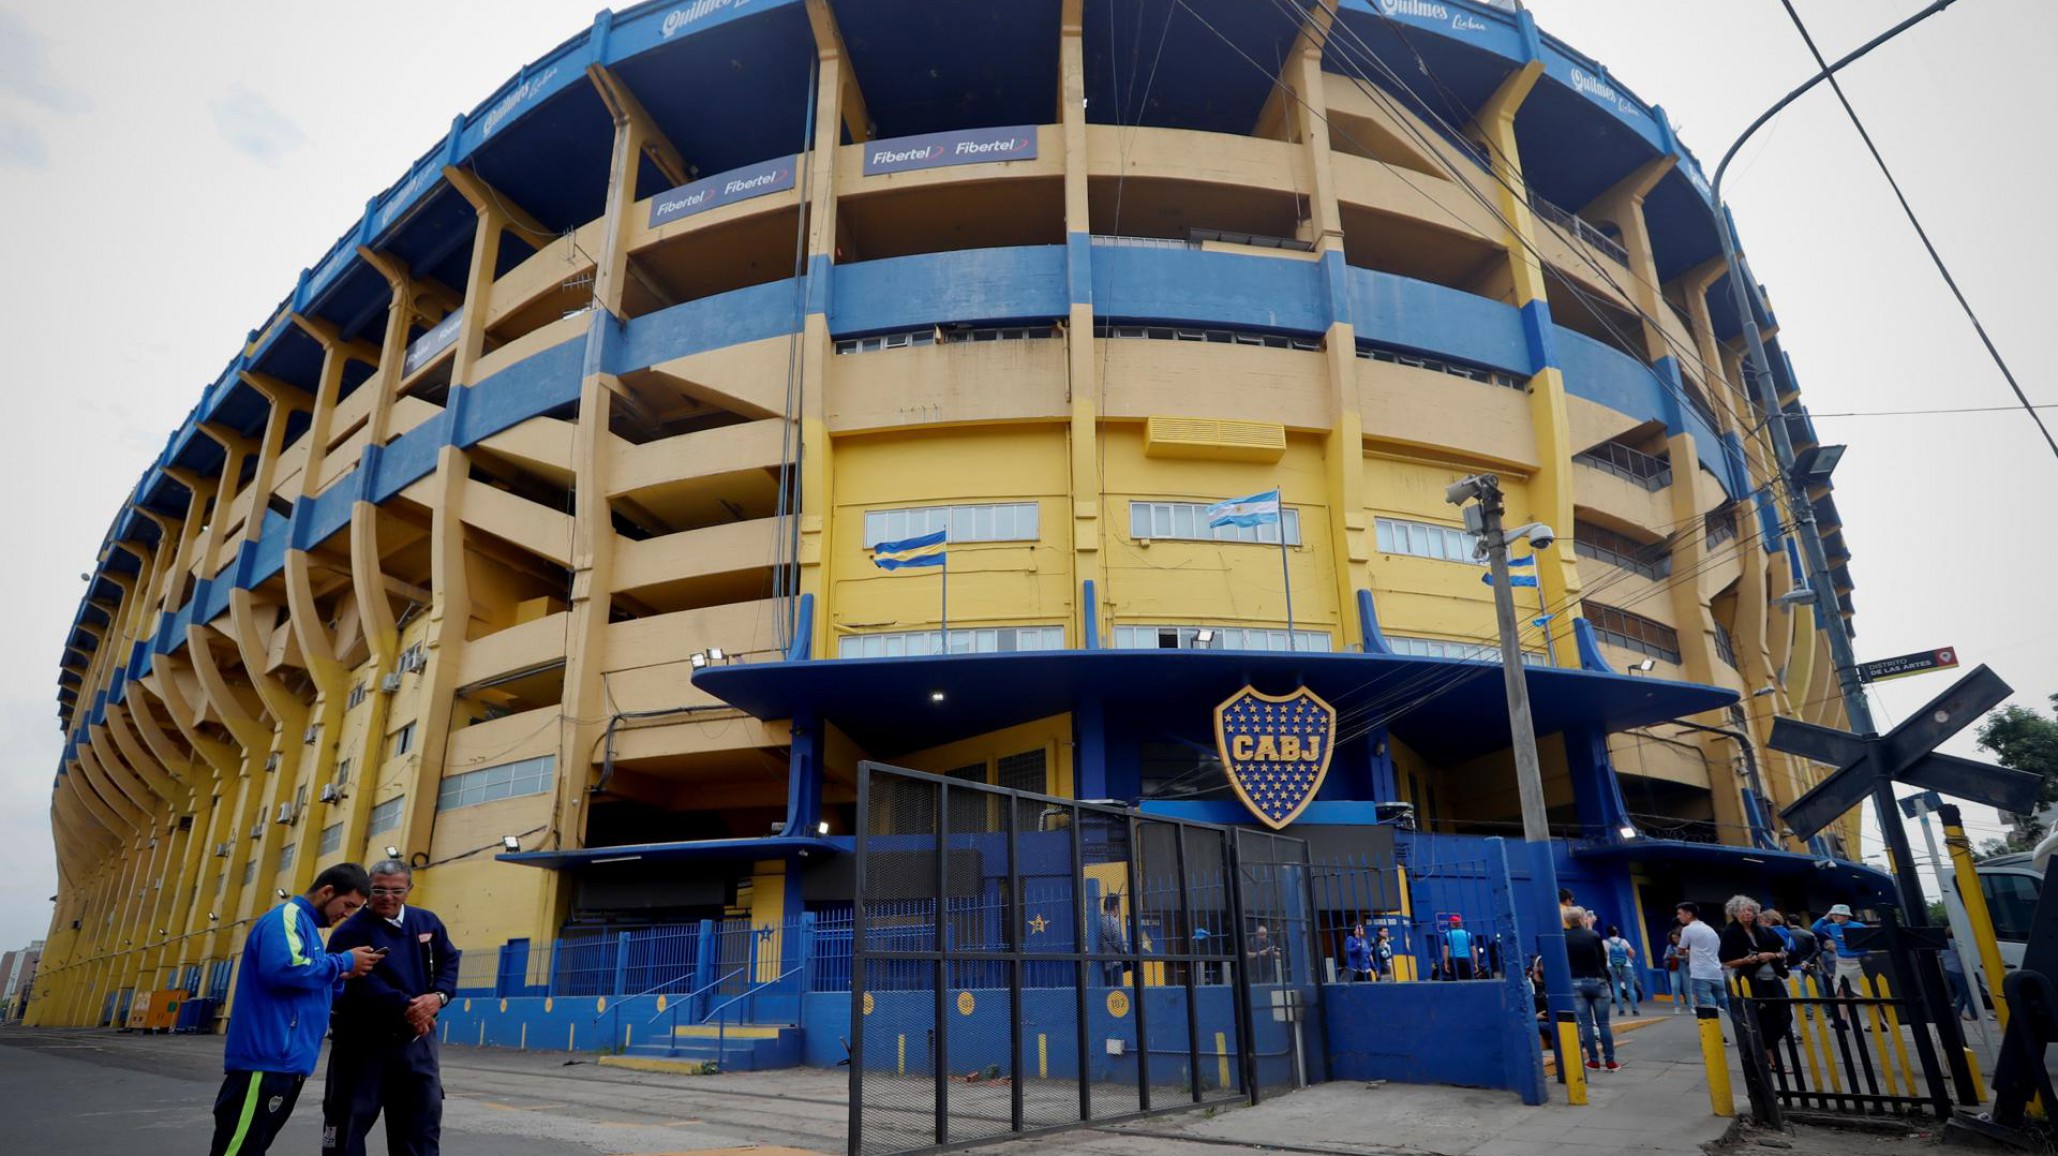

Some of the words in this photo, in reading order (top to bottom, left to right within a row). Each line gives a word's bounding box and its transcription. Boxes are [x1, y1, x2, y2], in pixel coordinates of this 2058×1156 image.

[1381, 0, 1448, 20] Quilmes
[1571, 67, 1616, 102] Quilmes
[873, 146, 931, 165] Fibertel
[955, 138, 1015, 155] Fibertel
[656, 190, 704, 217] Fibertel
[724, 171, 777, 195] Fibertel
[1868, 658, 1908, 670] DISTRITO
[1883, 666, 1901, 674] LAS
[1903, 659, 1932, 670] ARTES
[1232, 734, 1321, 761] CABJ
